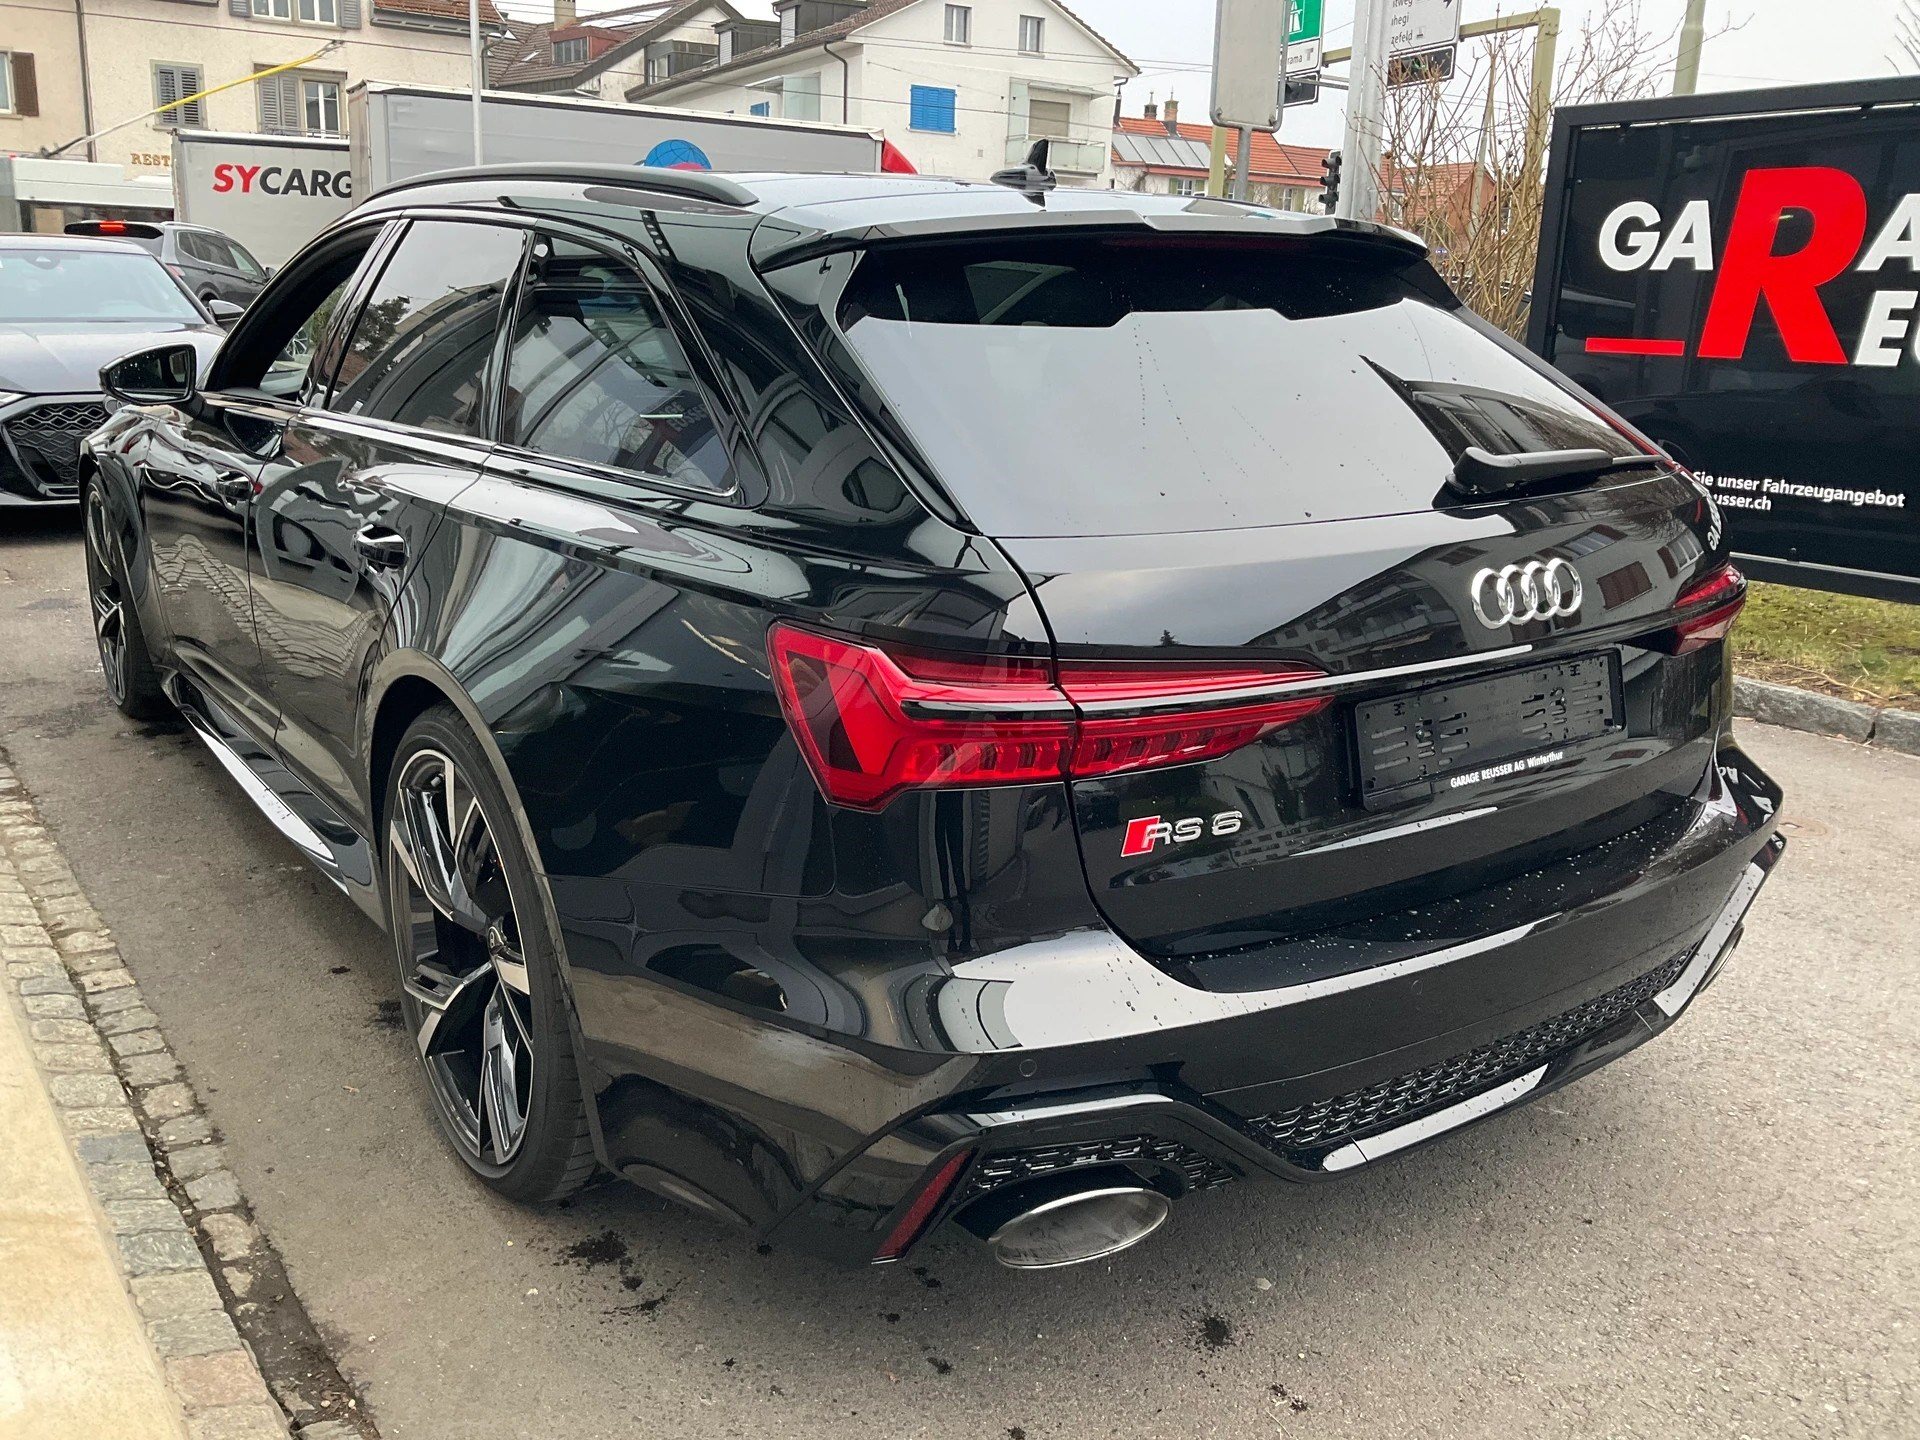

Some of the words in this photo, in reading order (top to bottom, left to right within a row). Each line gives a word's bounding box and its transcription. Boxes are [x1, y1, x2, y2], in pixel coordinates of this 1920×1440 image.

[212, 163, 352, 199] SYCARG
[1717, 474, 1760, 491] unser
[1762, 478, 1906, 508] Fahrzeugangebot
[1450, 771, 1480, 787] GARAGE
[1481, 764, 1512, 780] REUSSER
[1514, 760, 1525, 771] AG
[1527, 751, 1563, 767] Winterthur
